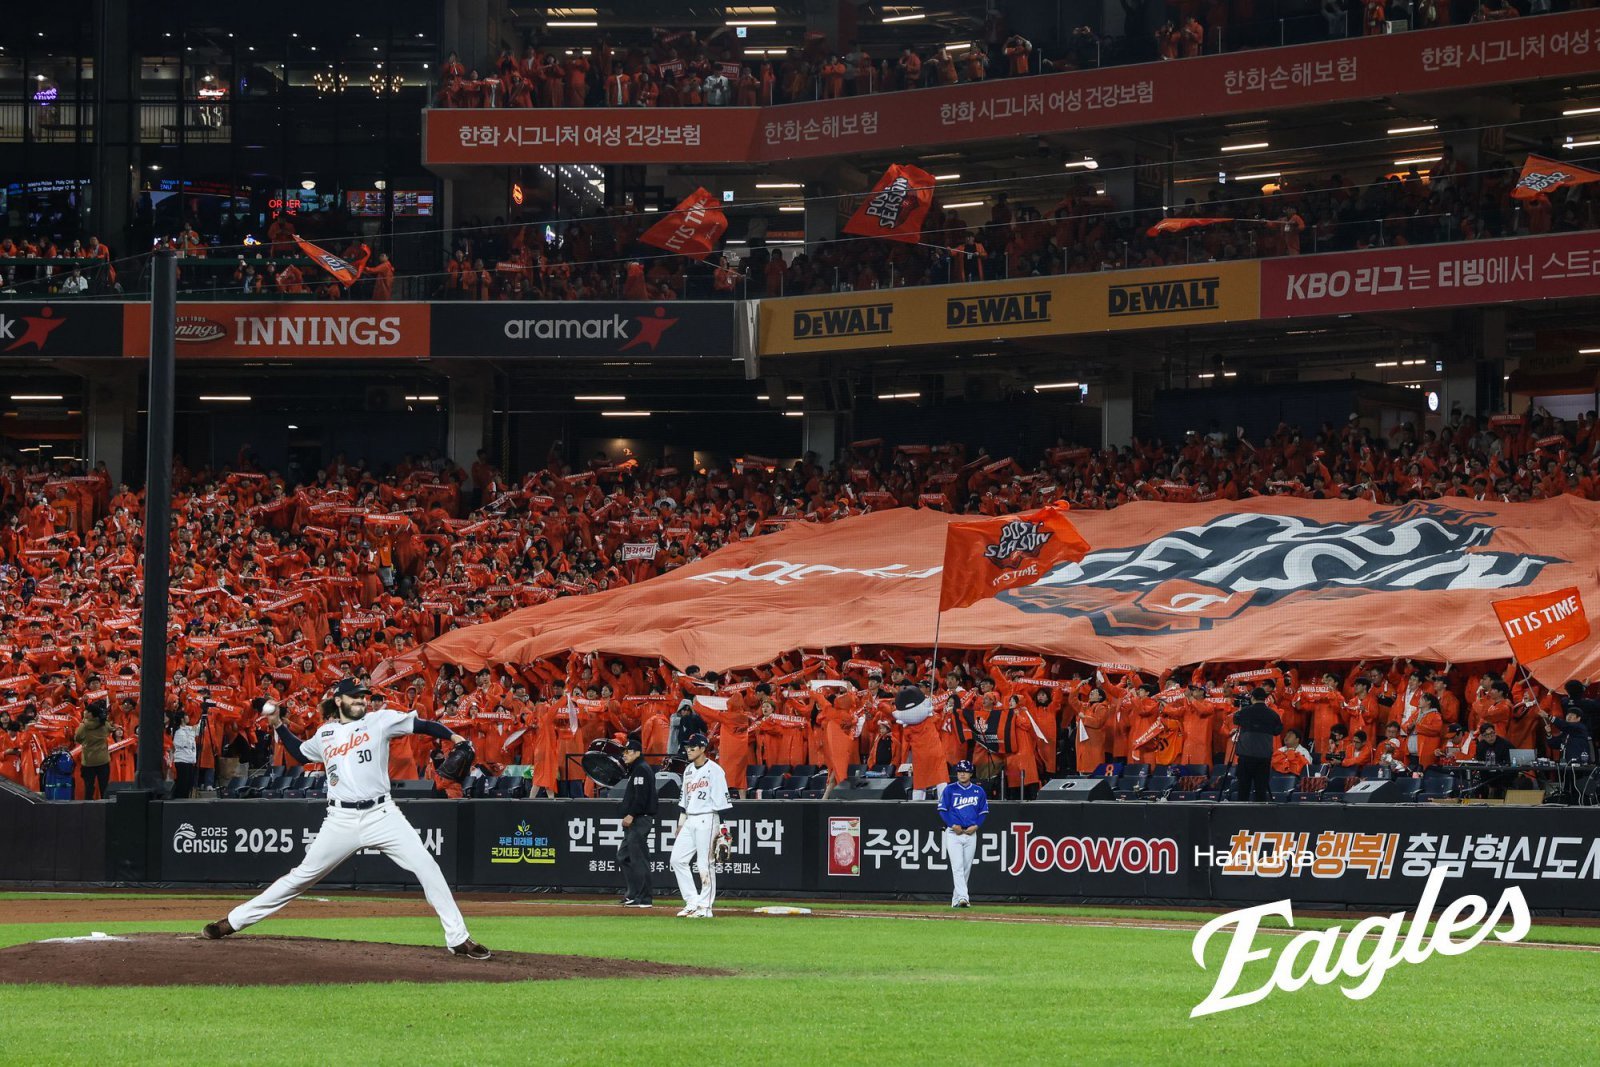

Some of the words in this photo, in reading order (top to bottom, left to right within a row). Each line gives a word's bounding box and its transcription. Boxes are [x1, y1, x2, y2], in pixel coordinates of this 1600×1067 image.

[1422, 46, 1462, 72] 한화
[1467, 34, 1545, 65] 시그니처
[1550, 29, 1589, 54] 여성
[1224, 56, 1358, 95] 한화손해보험
[940, 102, 975, 126] 한화
[978, 92, 1044, 121] 시그니처
[1049, 88, 1082, 112] 여성
[1085, 81, 1153, 108] 건강보험
[459, 126, 500, 147] 한화
[504, 126, 579, 147] 시그니처
[584, 126, 621, 147] 여성
[625, 126, 700, 147] 건강보험
[765, 112, 878, 145] 한화손해보험
[1287, 271, 1351, 300] KBO
[1355, 266, 1430, 295] 리그는
[1438, 255, 1533, 288] 티빙에서
[235, 317, 401, 346] INNINGS
[504, 313, 629, 339] aramark
[985, 532, 1051, 559] SEASON
[1012, 564, 1038, 578] TIME
[1504, 618, 1523, 638] IT
[1523, 611, 1542, 632] IS
[1539, 595, 1579, 624] TIME
[323, 731, 370, 763] Eagles
[357, 749, 372, 764] 30
[697, 791, 707, 800] 22
[953, 796, 979, 807] Lions
[174, 836, 228, 853] Census
[201, 827, 228, 837] 2025
[235, 829, 293, 853] 2025
[498, 837, 512, 846] 푸른
[513, 837, 533, 846] 미래를
[534, 837, 548, 846] 열다
[491, 847, 520, 857] 국가대표
[526, 847, 556, 858] 기술교육
[1008, 822, 1178, 876] Joowon
[1311, 831, 1400, 880] 행복!
